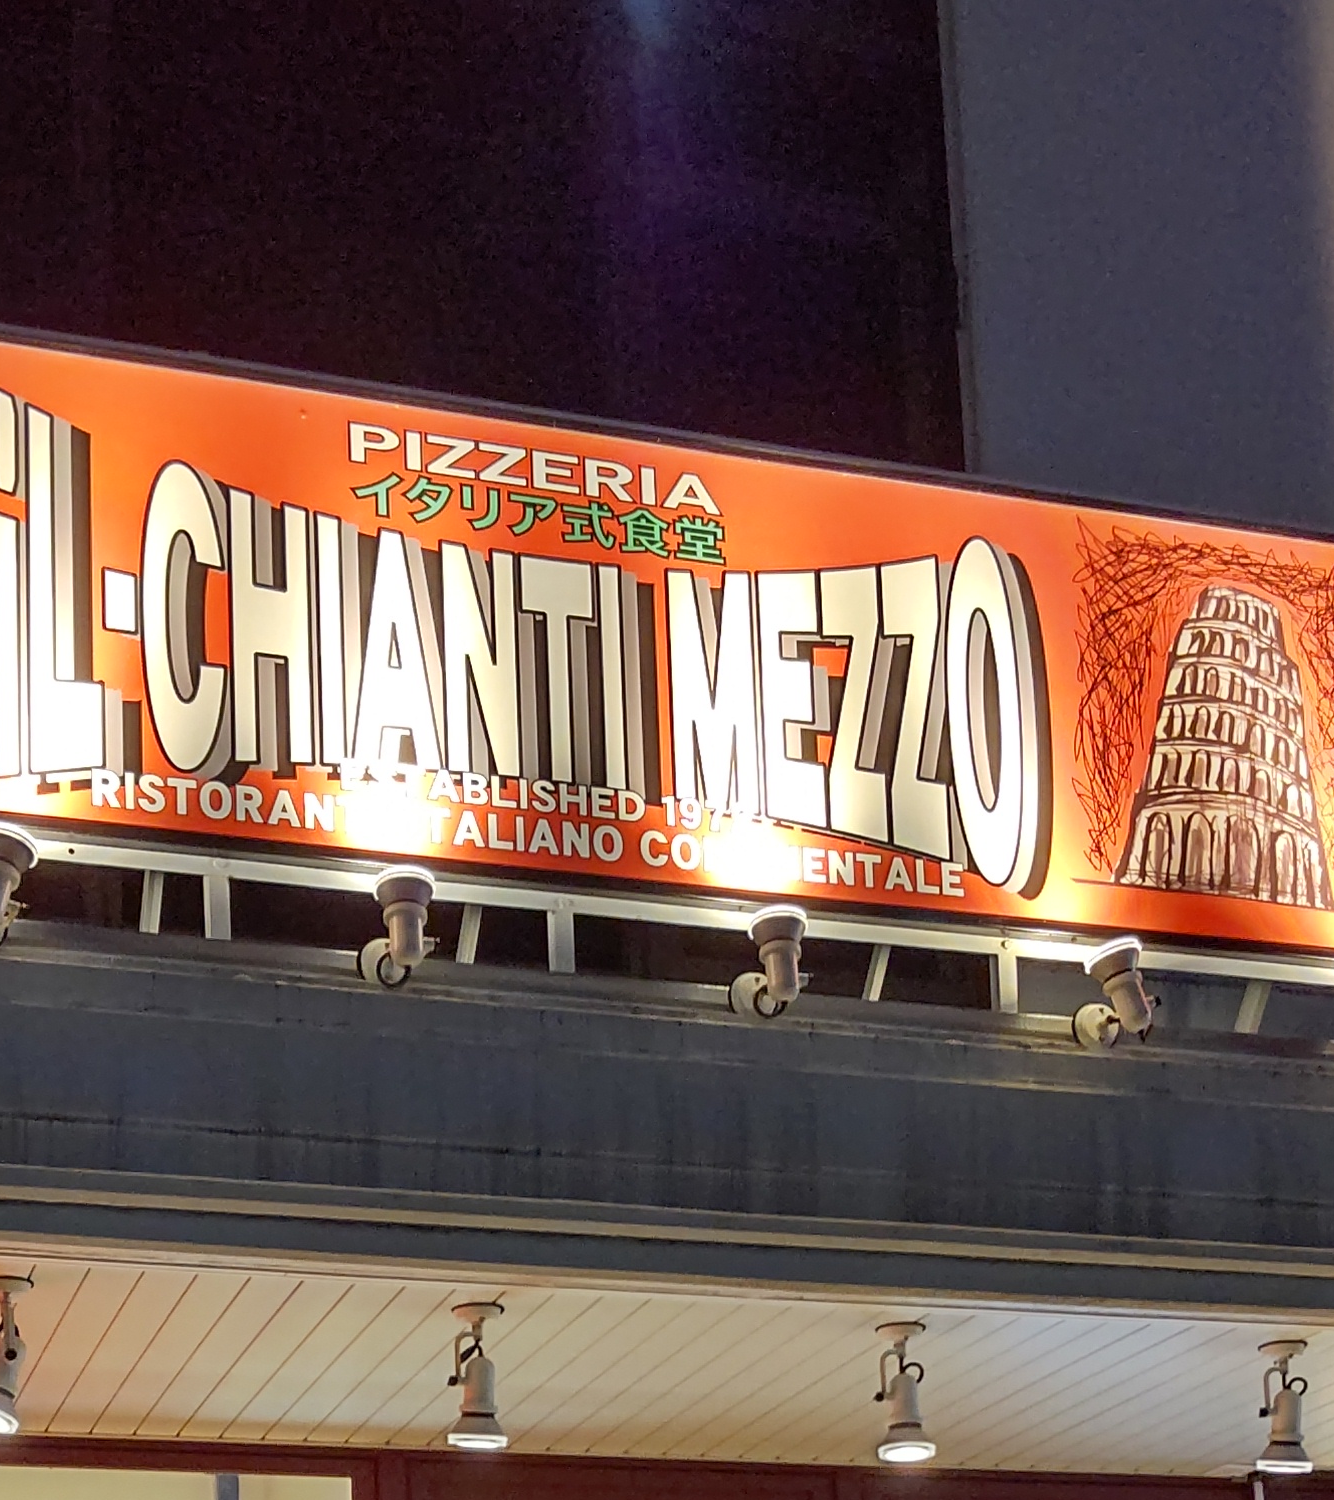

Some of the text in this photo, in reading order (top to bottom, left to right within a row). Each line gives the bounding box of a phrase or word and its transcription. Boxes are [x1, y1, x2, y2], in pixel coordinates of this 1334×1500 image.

[348, 421, 724, 516] PIZZERIA
[353, 474, 726, 565] イタリア式食堂
[666, 535, 1042, 893] MEZZO
[90, 767, 966, 897] RISTORAN TALIANO COENTALE
[341, 757, 757, 833] EABLISHED 197
